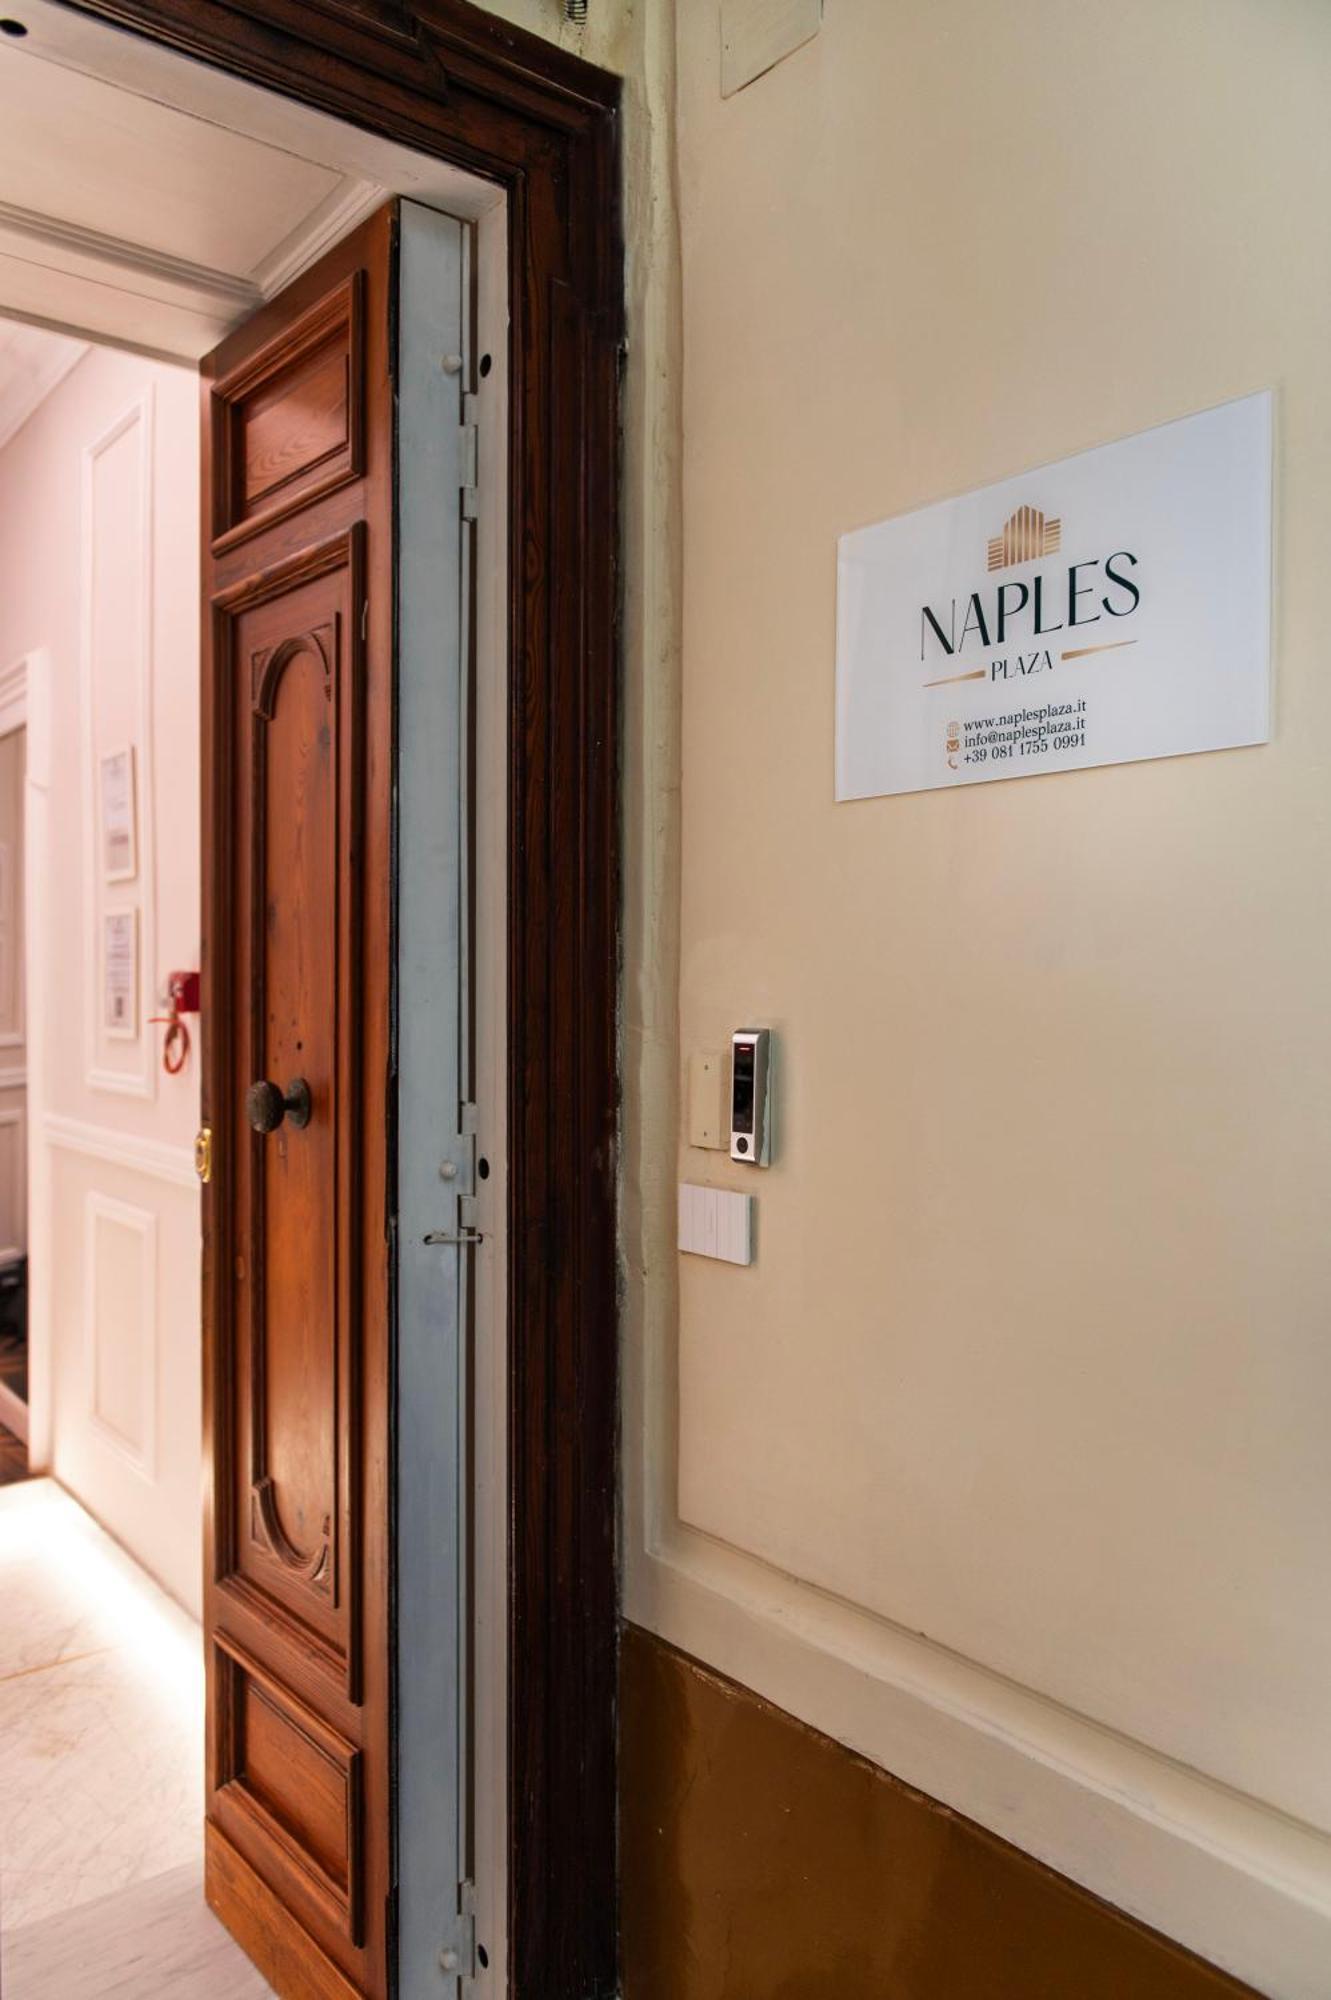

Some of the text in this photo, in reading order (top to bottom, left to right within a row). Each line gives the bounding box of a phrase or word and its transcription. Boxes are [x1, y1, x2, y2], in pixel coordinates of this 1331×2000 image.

[921, 552, 1140, 661] NAPLES
[991, 650, 1053, 681] PLAZA
[963, 699, 1087, 732] www.naplesplaza.it
[964, 716, 1086, 748] info@naplesplaza.it
[964, 733, 1086, 763] +39 081 1755 0991
